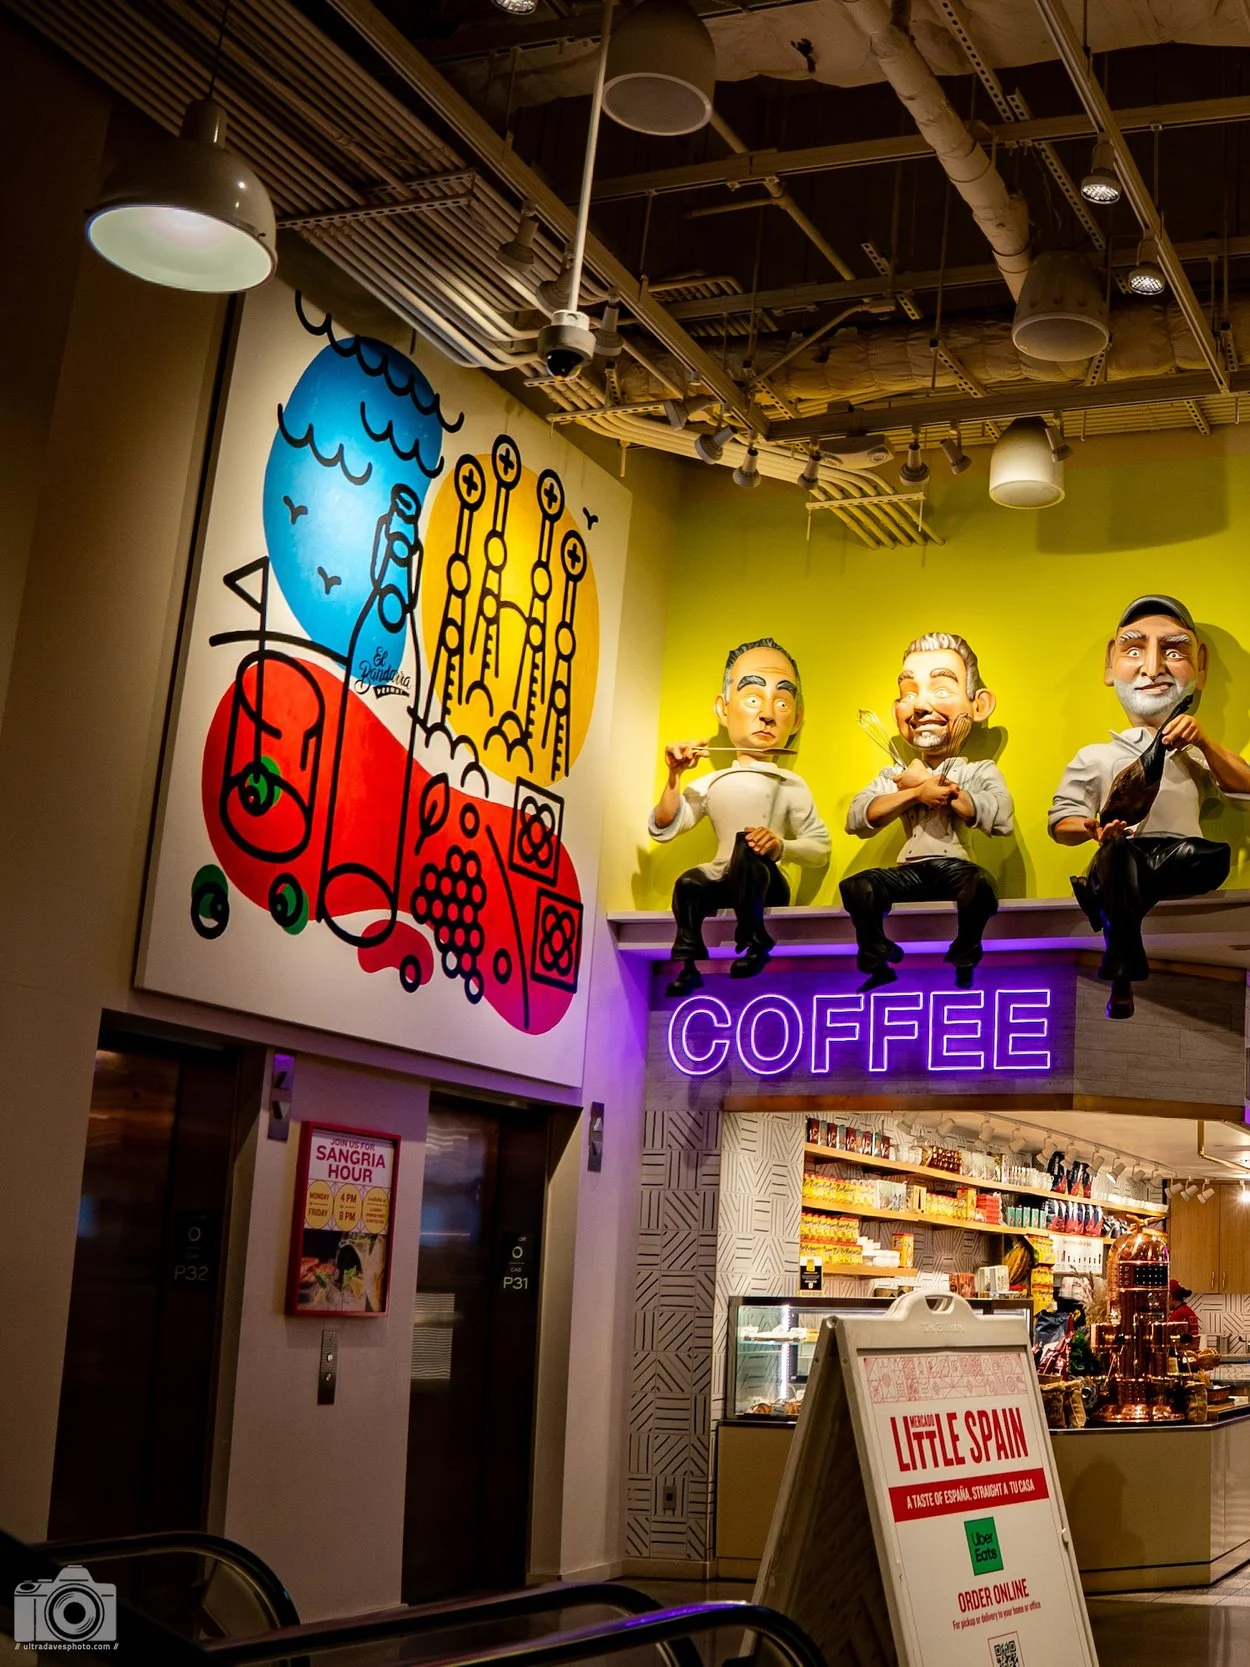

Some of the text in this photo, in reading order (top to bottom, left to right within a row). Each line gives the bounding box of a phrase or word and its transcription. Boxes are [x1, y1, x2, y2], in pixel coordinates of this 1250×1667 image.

[668, 990, 1050, 1076] COFFEE
[331, 1139, 375, 1151] JOIN US FOR
[316, 1145, 385, 1168] SANGRIA
[328, 1164, 373, 1183] HOUR
[309, 1192, 330, 1200] MONDAY
[341, 1194, 357, 1203] 4 PM
[308, 1208, 328, 1217] FRIDAY
[345, 1212, 355, 1220] PM
[175, 1266, 208, 1280] P32
[503, 1277, 528, 1289] P31
[909, 1414, 935, 1428] MERCADO
[890, 1407, 1029, 1472] LITTLE SPAIN
[907, 1478, 1035, 1510] A TASTE OF ESPAÑA, STRAIGHT A TU CASA
[971, 1532, 993, 1546] Uber
[974, 1548, 997, 1563] Eats
[958, 1578, 1029, 1613] ORDER ONLINE
[952, 1620, 960, 1630] For
[961, 1617, 976, 1630] pickup
[981, 1612, 998, 1623] delivery
[1003, 1609, 1012, 1620] your
[1012, 1606, 1024, 1615] home
[1029, 1600, 1041, 1611] office
